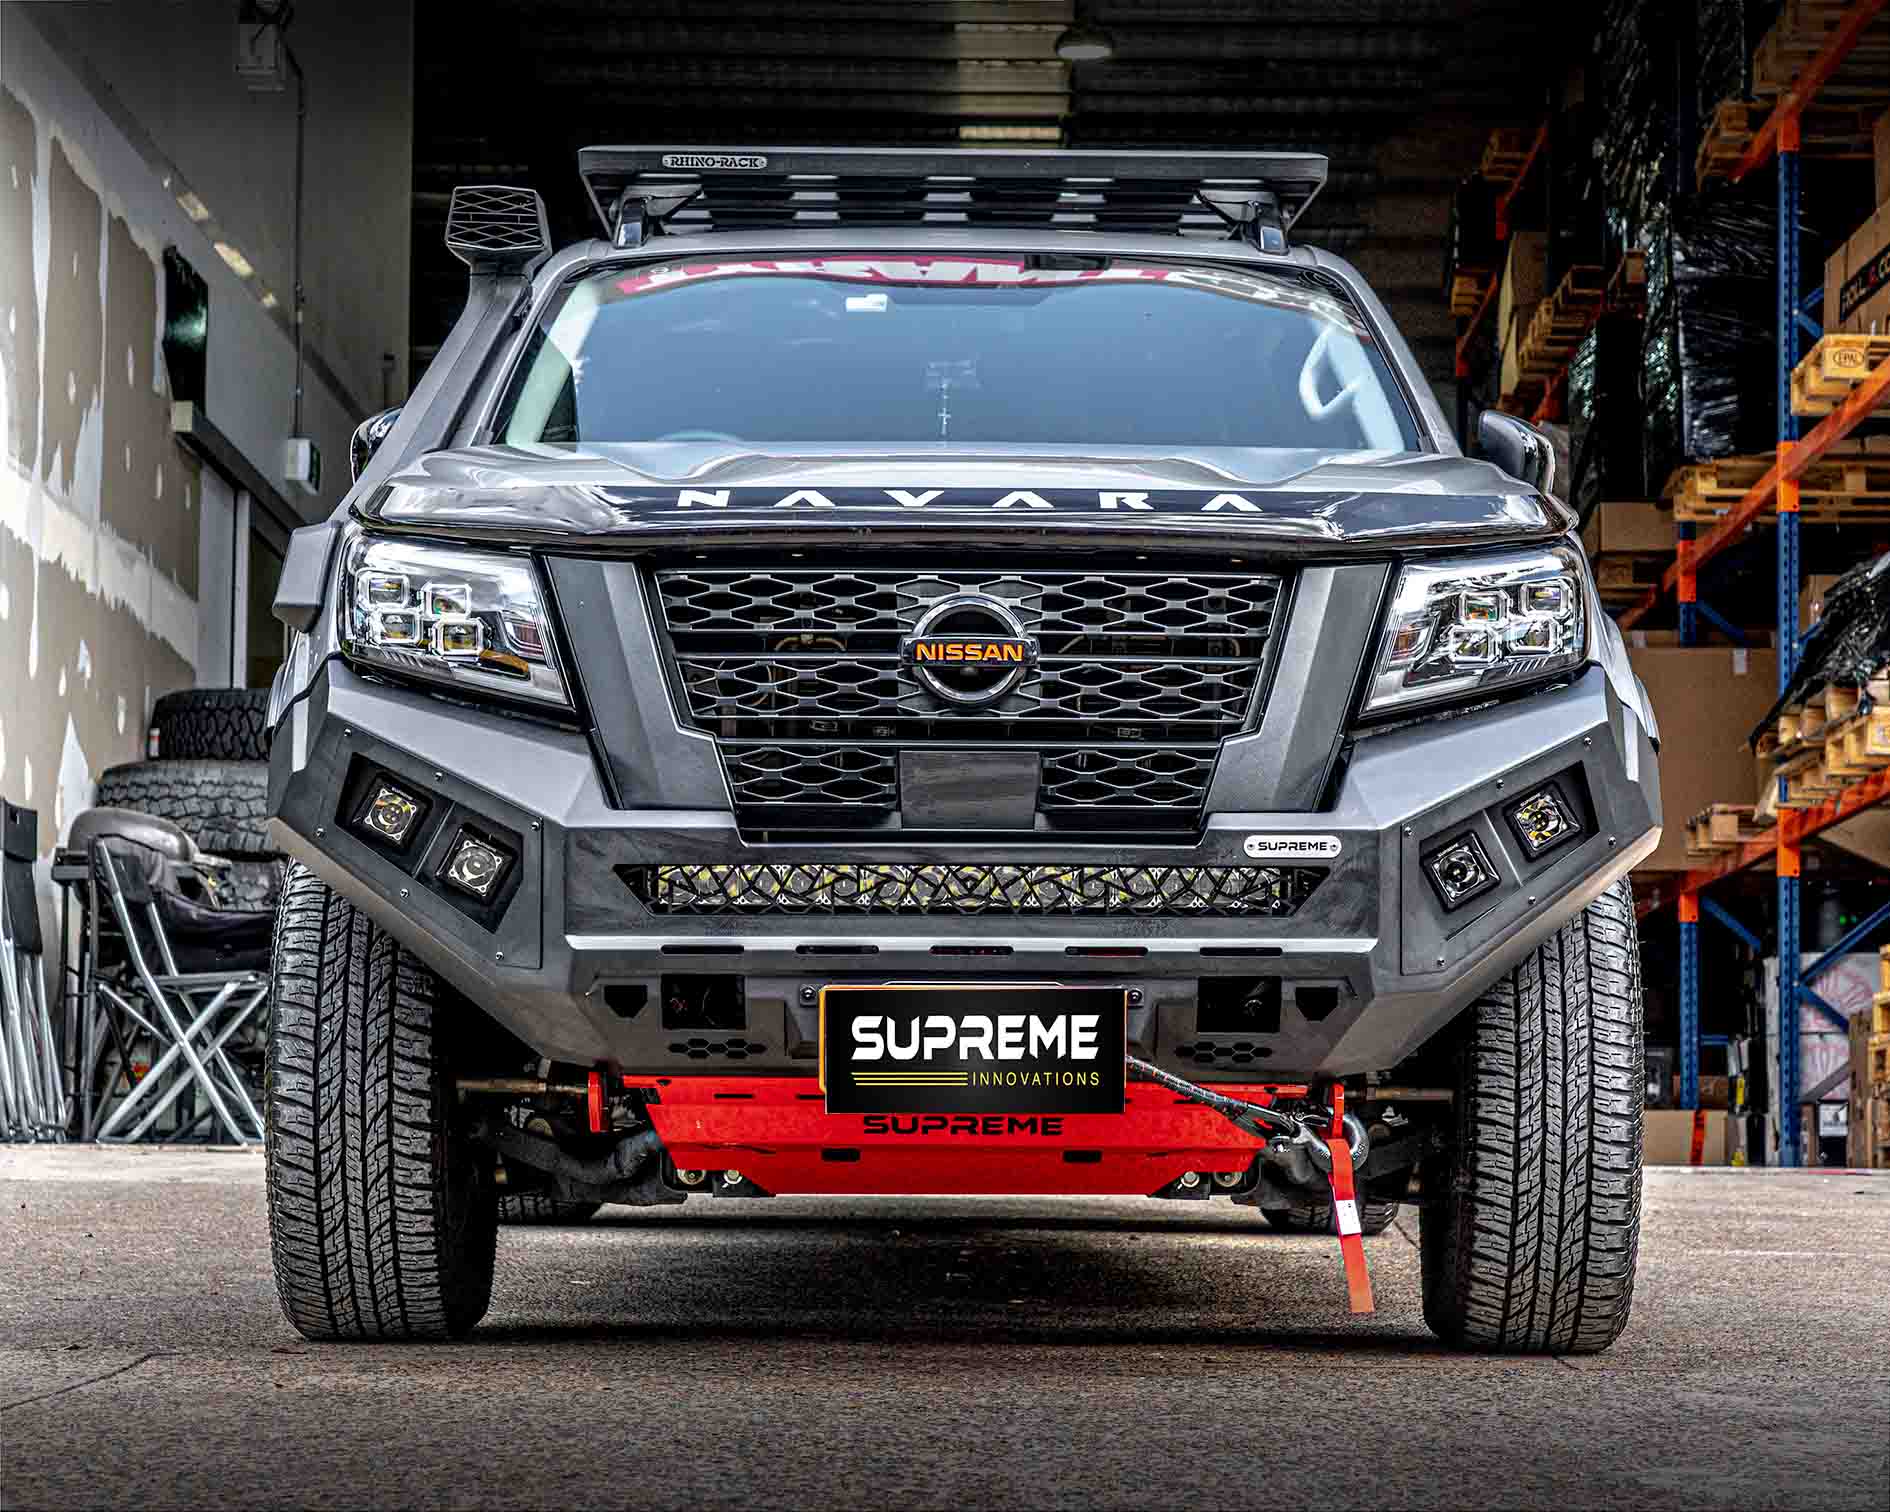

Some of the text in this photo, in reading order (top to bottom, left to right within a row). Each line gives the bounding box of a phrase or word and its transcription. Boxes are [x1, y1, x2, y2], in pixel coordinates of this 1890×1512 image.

[670, 156, 760, 168] RHINO-RACK
[676, 489, 1264, 512] NAVARA
[915, 643, 1025, 662] NISSAN
[1257, 841, 1328, 851] SUPREME
[851, 1014, 1101, 1060] SUPREME
[972, 1071, 1100, 1086] INNOVATIONS
[862, 1115, 1065, 1136] SUPREME
